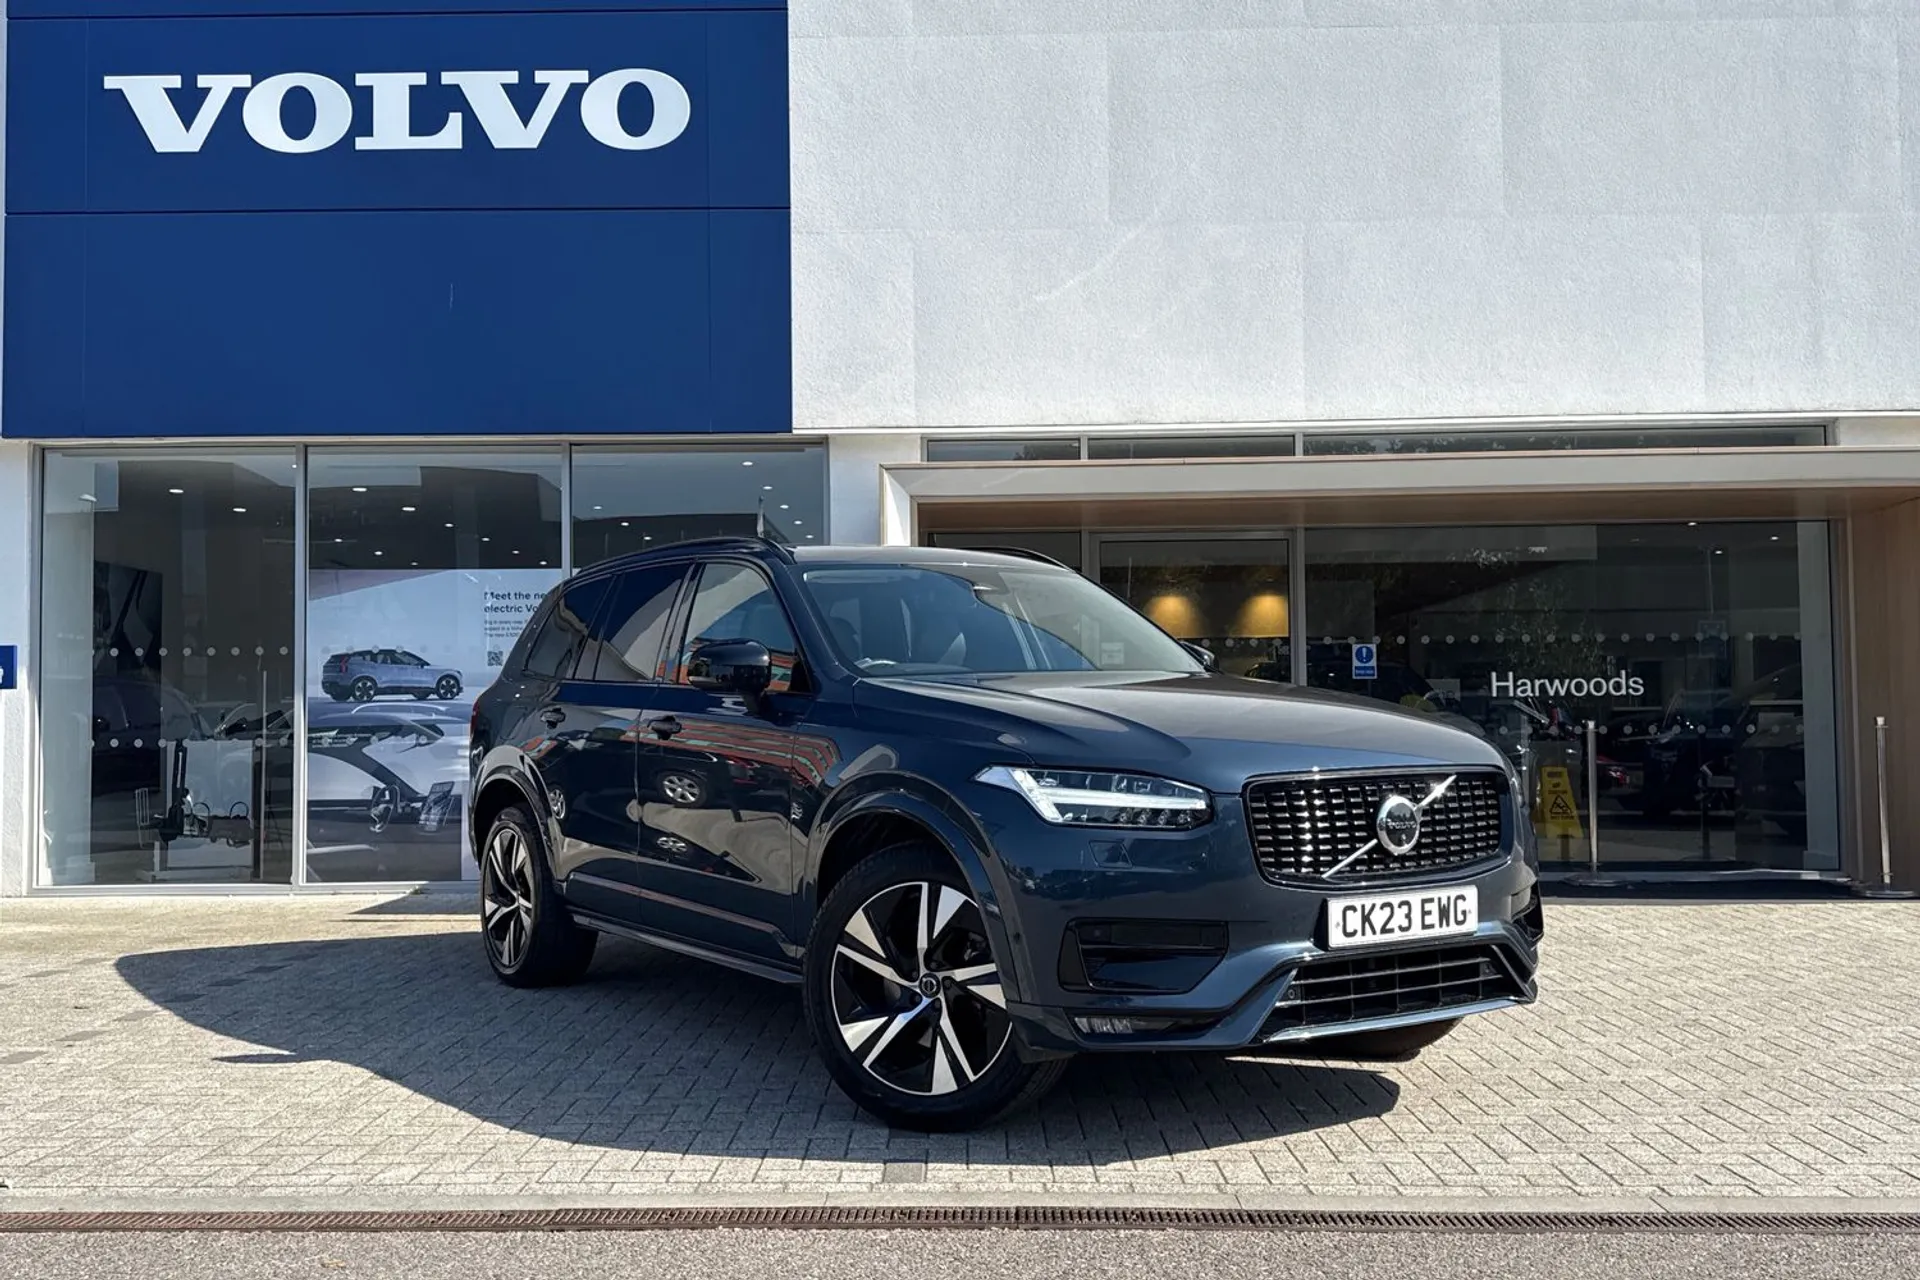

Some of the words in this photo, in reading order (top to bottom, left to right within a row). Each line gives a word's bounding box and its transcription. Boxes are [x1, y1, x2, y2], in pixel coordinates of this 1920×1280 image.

[103, 68, 691, 153] VOLVO
[484, 591, 511, 600] Meet
[514, 591, 531, 600] the
[484, 604, 523, 613] electric
[1491, 669, 1644, 697] Harwoods
[1342, 899, 1412, 938] CK23
[1421, 894, 1467, 930] EWG
